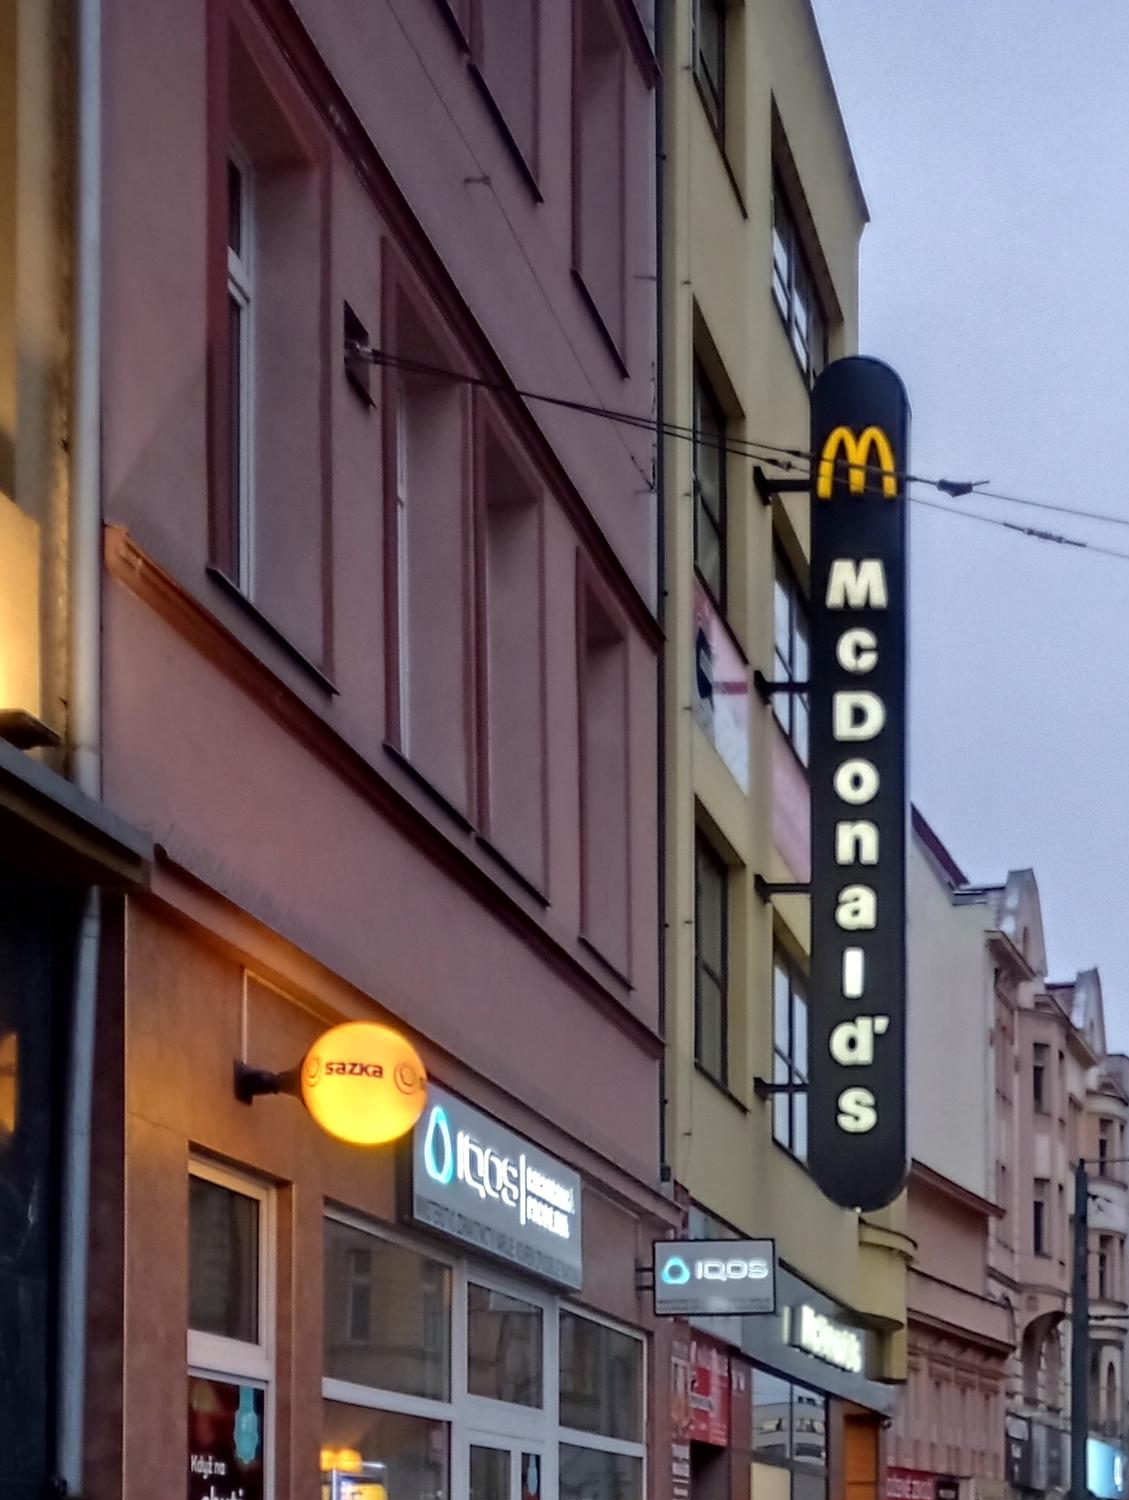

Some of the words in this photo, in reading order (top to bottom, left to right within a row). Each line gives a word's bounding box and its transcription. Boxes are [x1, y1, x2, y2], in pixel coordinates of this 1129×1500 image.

[826, 558, 890, 1133] McDonald's
[456, 1130, 519, 1207] IQOS
[695, 1258, 769, 1282] IQOS
